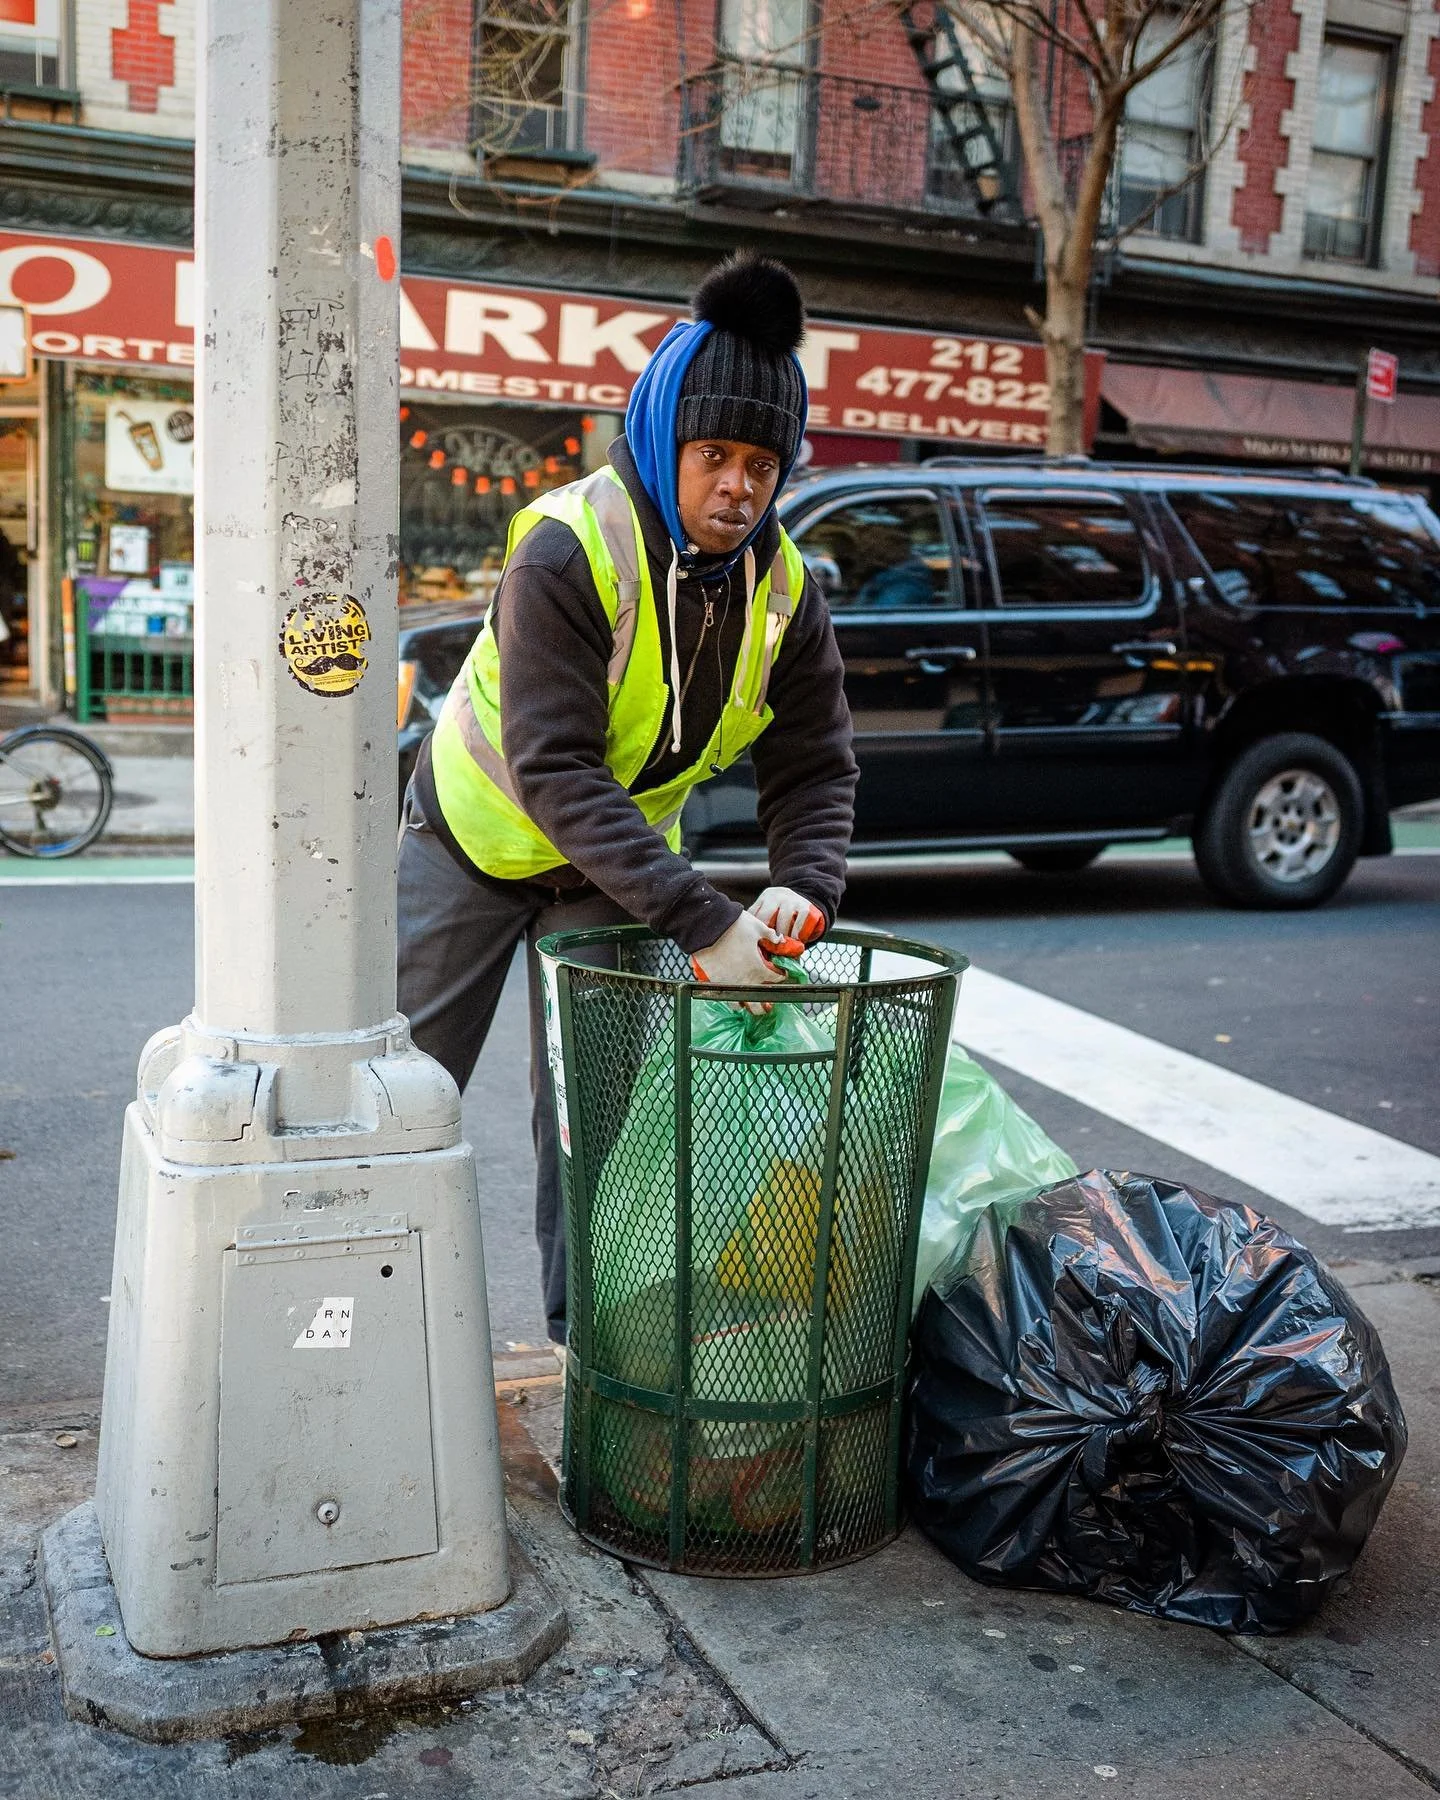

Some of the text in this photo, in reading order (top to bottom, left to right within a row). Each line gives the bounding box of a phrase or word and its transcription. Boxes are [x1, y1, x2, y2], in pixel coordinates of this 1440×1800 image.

[929, 338, 1024, 375] 212
[32, 331, 195, 364] ORTE
[399, 365, 628, 406] MESTIC
[842, 407, 1049, 442] DELIVER
[855, 366, 1052, 411] 477-822
[288, 623, 367, 645] LIVING
[313, 1309, 350, 1319] RN
[305, 1329, 348, 1339] DAY
